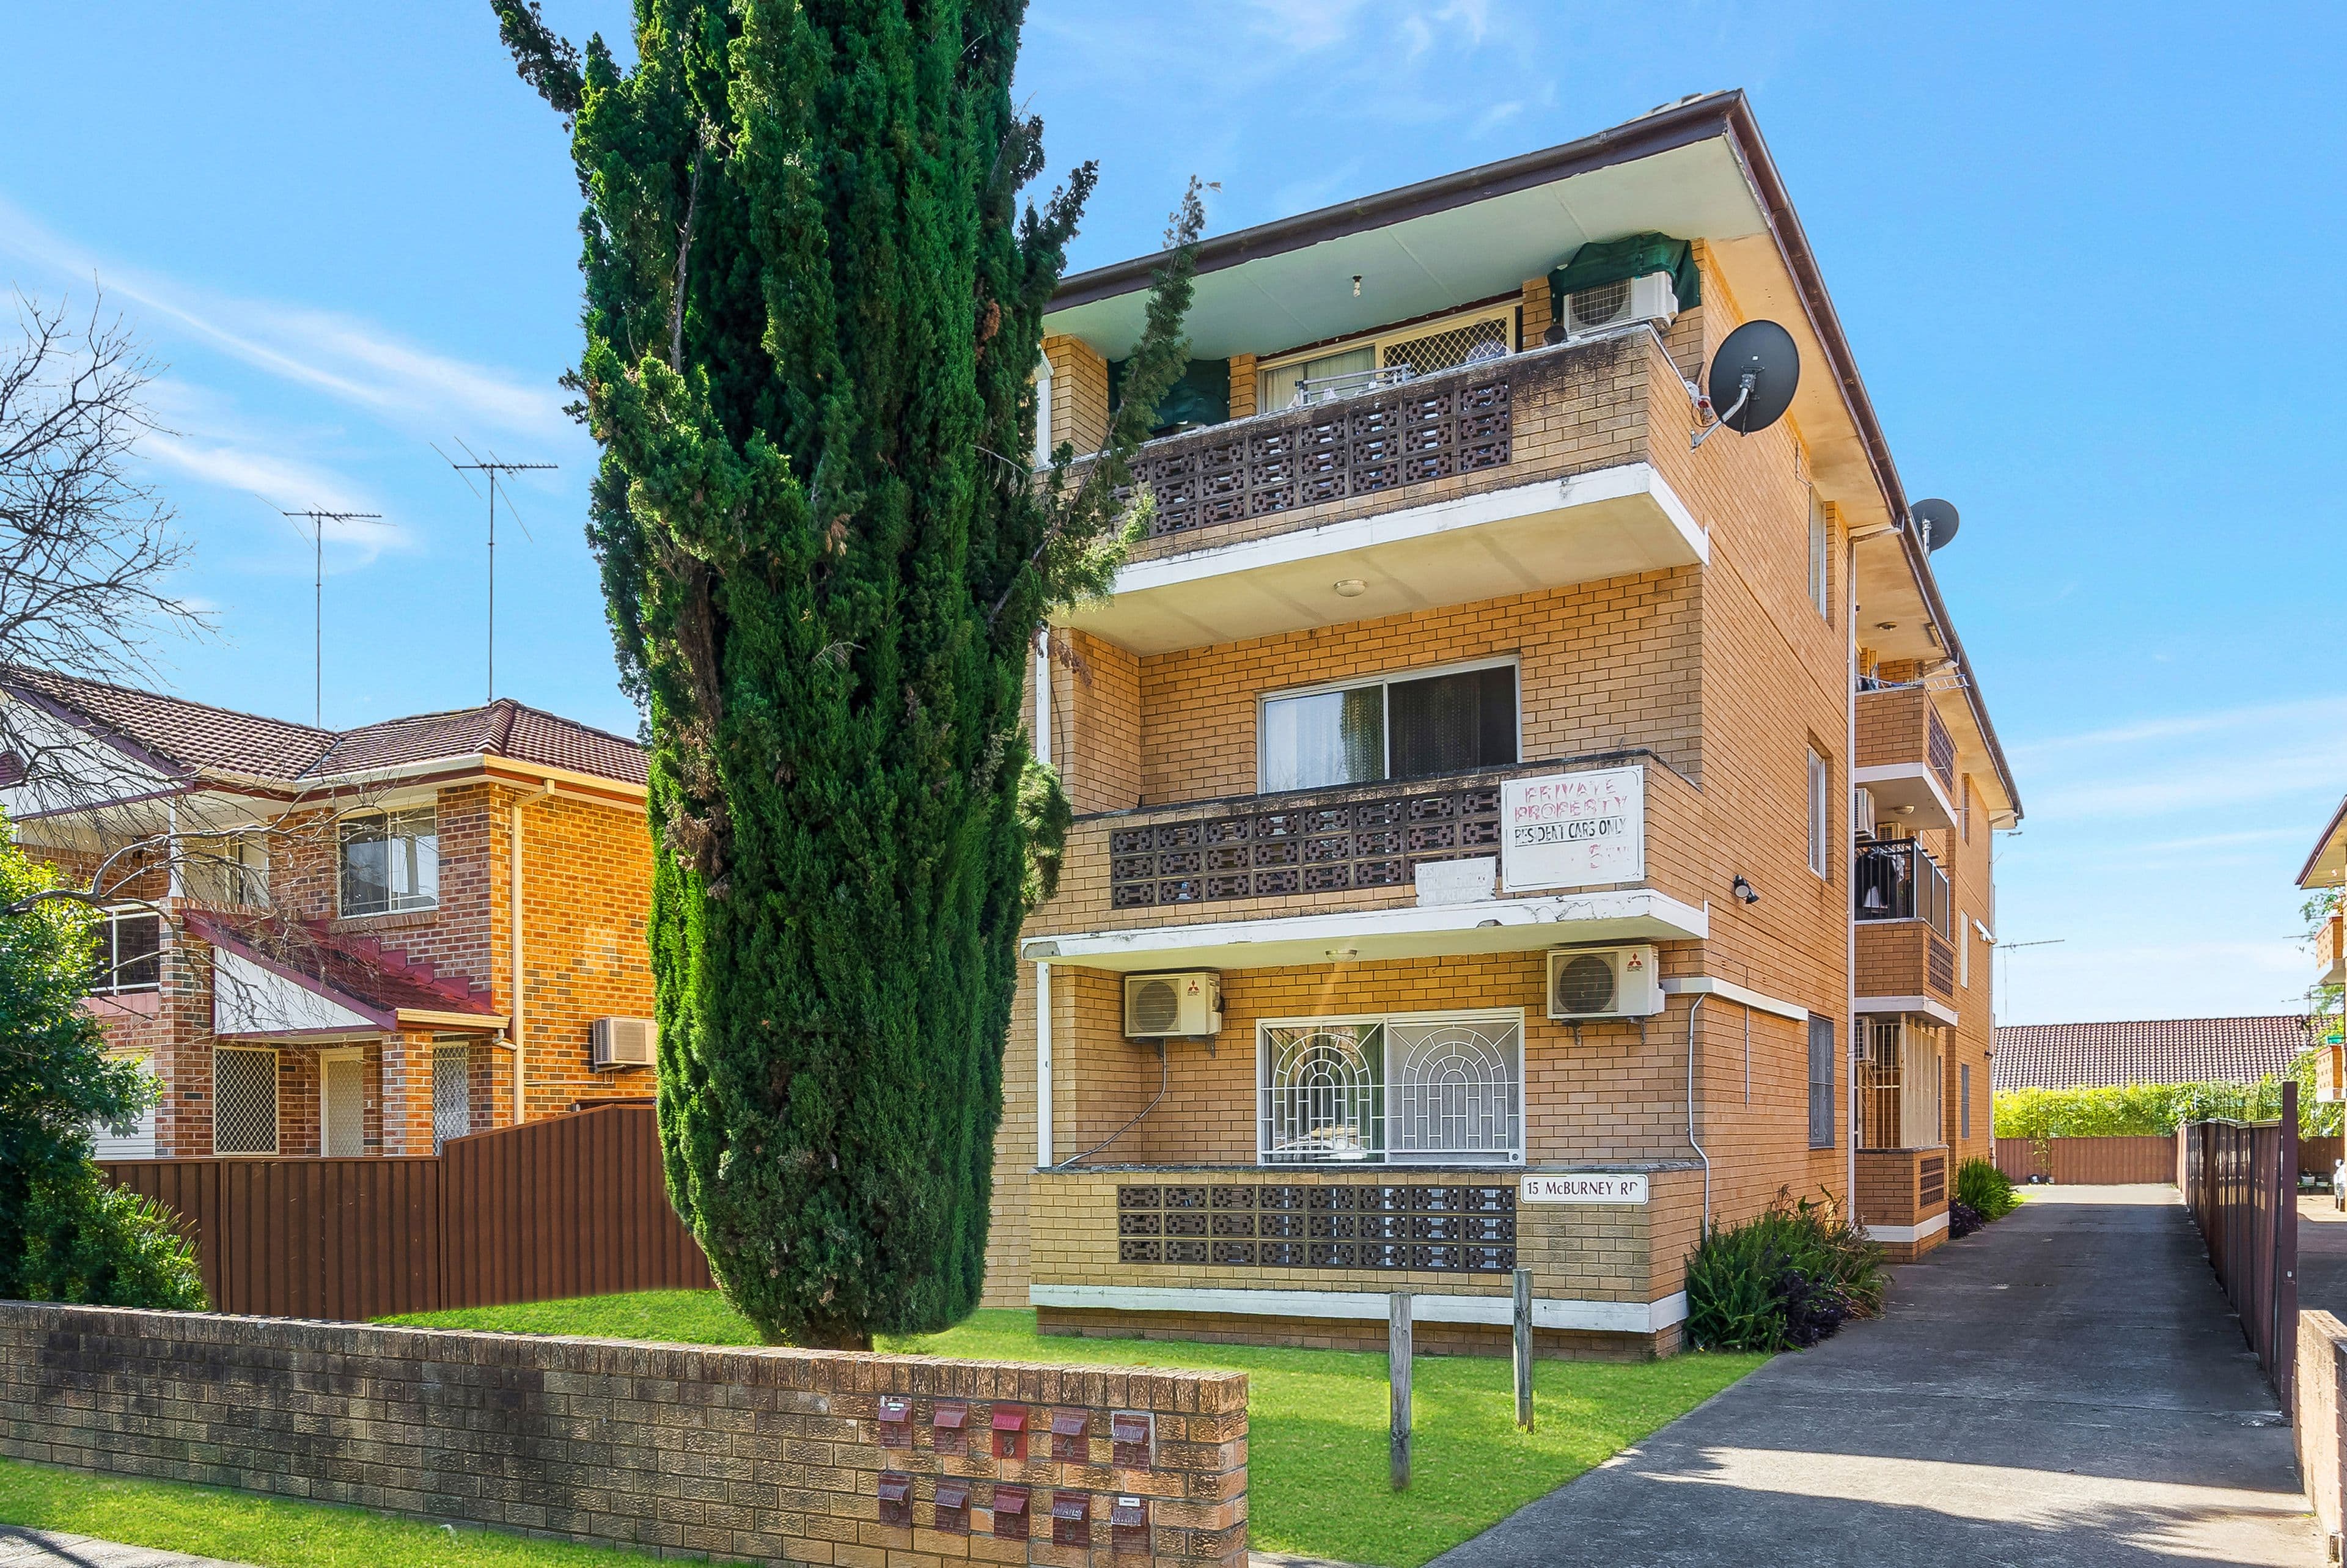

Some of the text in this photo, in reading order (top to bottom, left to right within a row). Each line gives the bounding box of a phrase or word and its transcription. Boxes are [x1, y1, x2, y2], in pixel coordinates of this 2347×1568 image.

[1515, 796, 1628, 822] PROPERTY
[1515, 818, 1626, 844] RESDENT CARS ONLY
[1527, 1181, 1538, 1195] 15
[1545, 1181, 1614, 1195] McBURNEY
[943, 1431, 957, 1450] 2
[1002, 1436, 1015, 1457] 3
[1060, 1438, 1074, 1457] 4
[1124, 1446, 1138, 1465] 5
